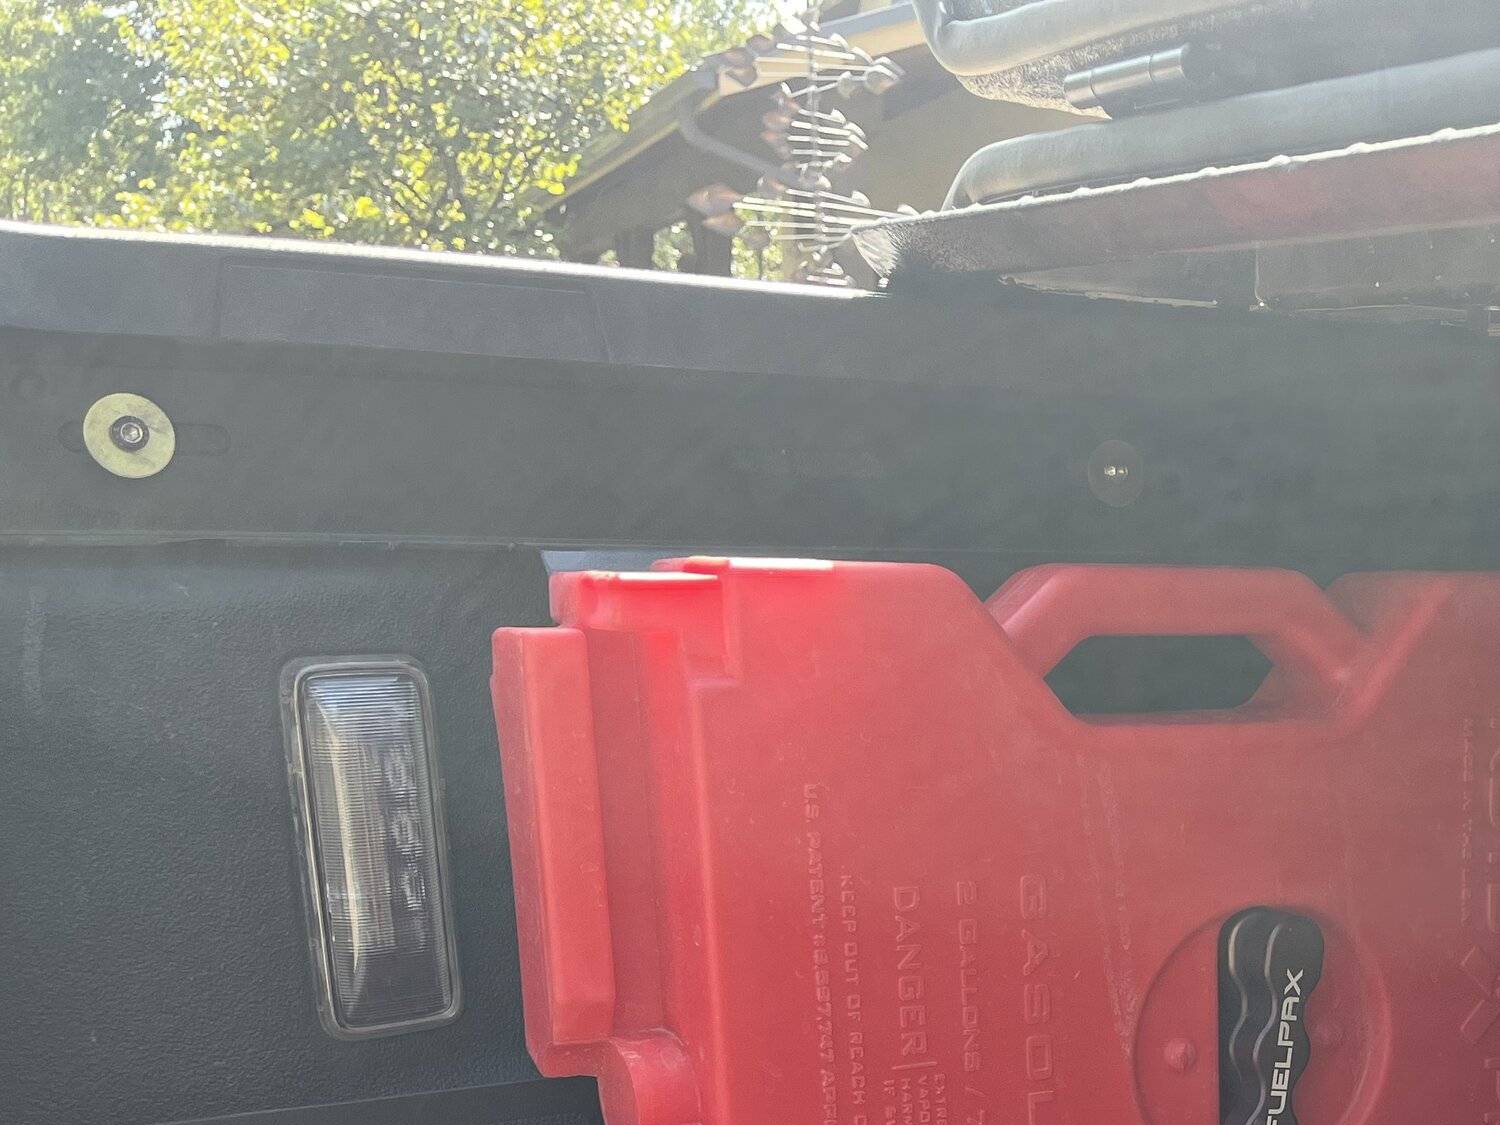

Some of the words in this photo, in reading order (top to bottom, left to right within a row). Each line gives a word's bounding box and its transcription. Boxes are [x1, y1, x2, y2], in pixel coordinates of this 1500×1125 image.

[804, 783, 820, 824] U.S.
[807, 831, 827, 929] PATENT
[841, 874, 857, 932] KEEP
[956, 880, 977, 905] 2
[844, 941, 859, 984] OUT
[892, 885, 928, 1056] DANGER
[847, 994, 862, 1022] OF
[958, 918, 984, 1073] GALLONS
[849, 1031, 866, 1105] REACH
[882, 1079, 895, 1097] IF
